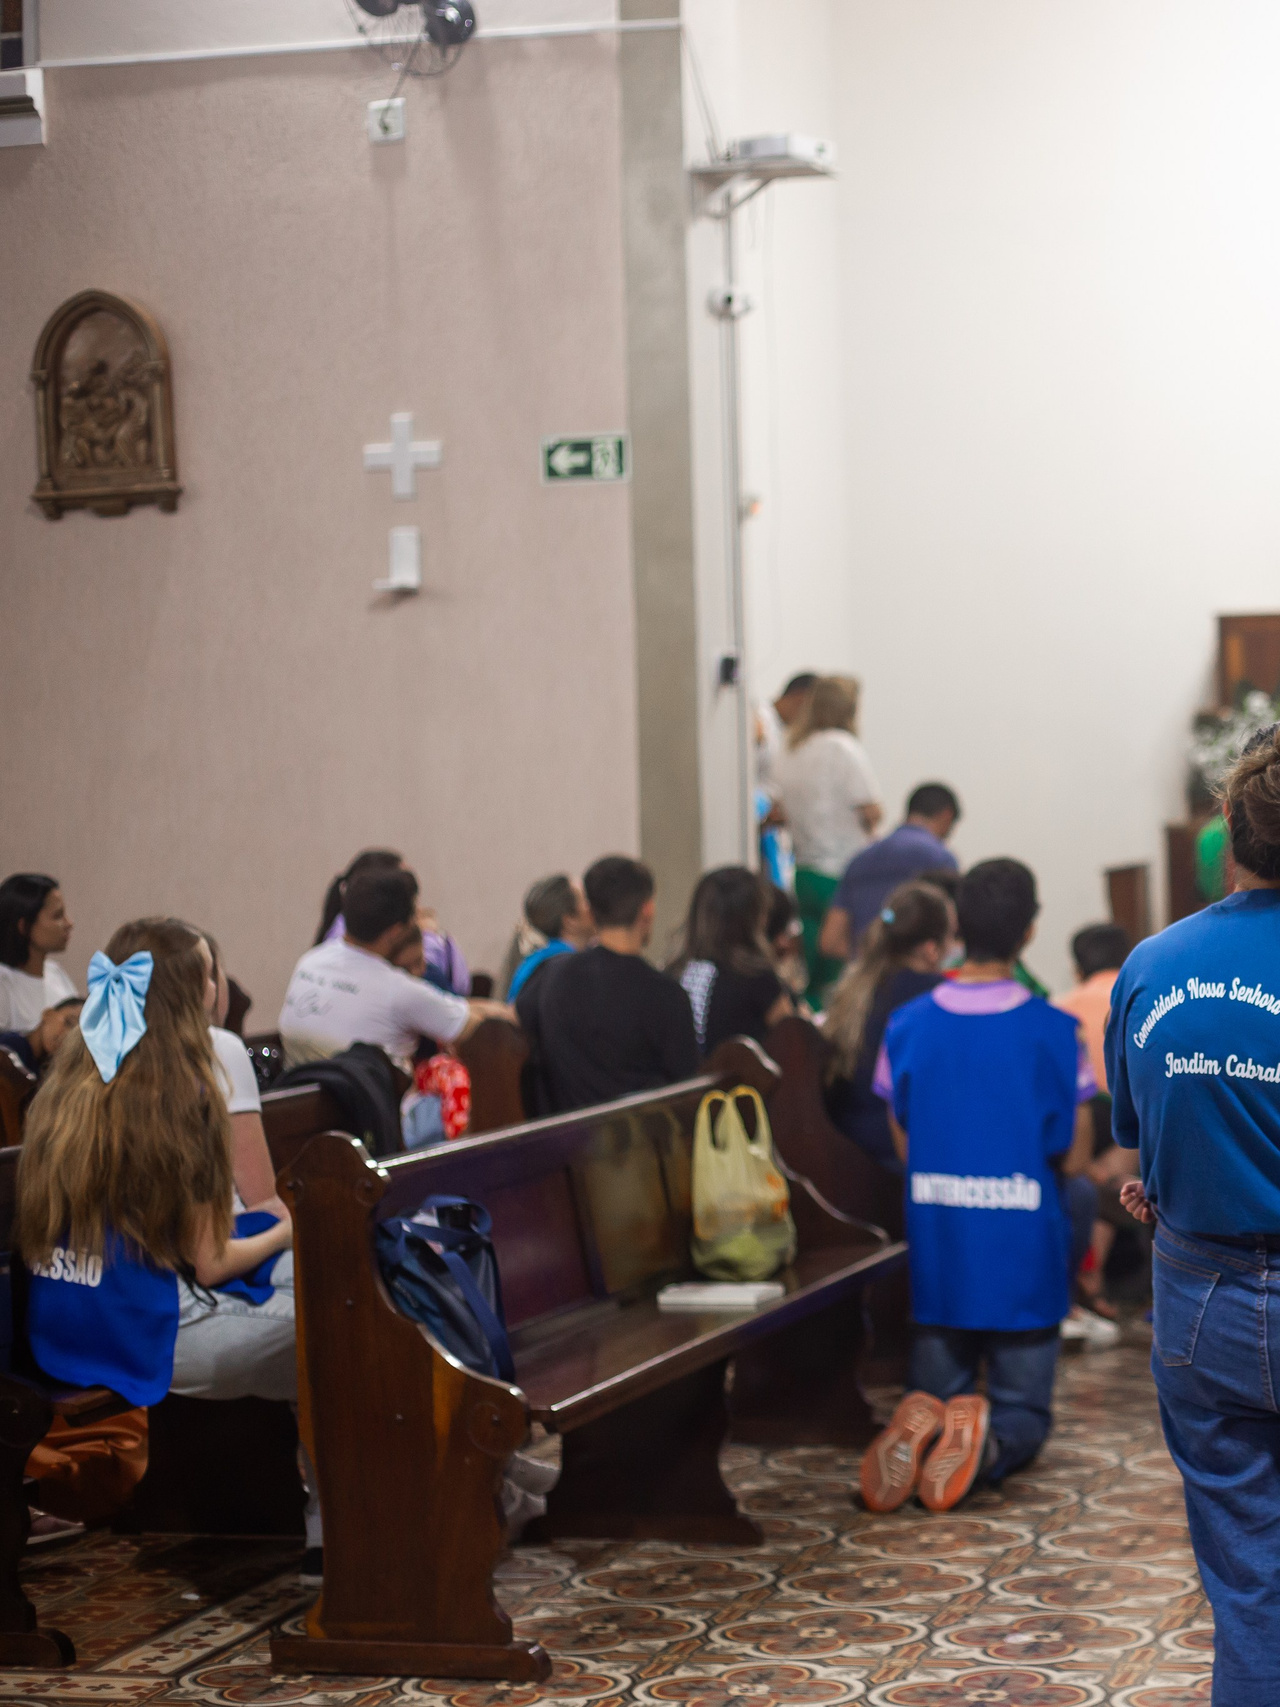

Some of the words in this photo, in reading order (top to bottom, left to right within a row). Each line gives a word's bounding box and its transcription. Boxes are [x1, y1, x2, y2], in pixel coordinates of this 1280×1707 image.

[1133, 985, 1185, 1049] Comunidade
[1186, 976, 1226, 1000] Nossa
[1165, 1051, 1222, 1078] Jardim
[911, 1171, 1042, 1211] INTERCESSÃO
